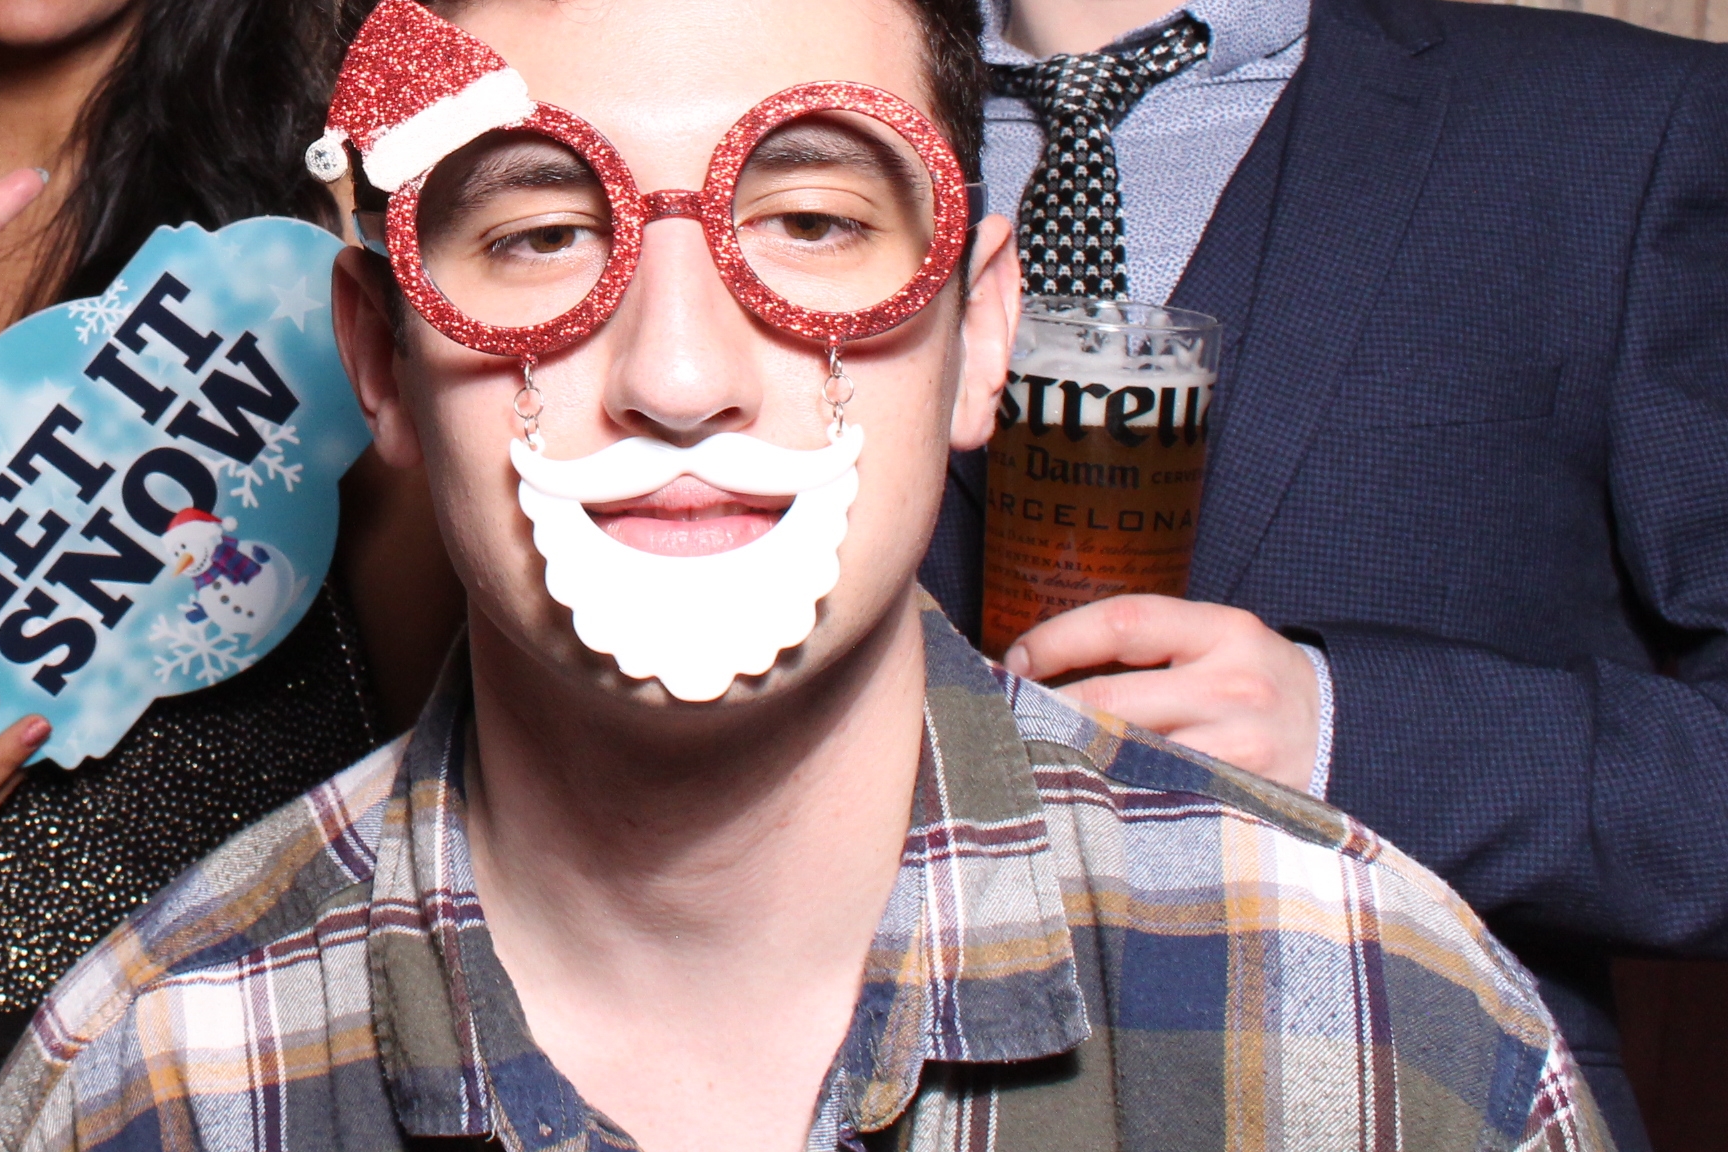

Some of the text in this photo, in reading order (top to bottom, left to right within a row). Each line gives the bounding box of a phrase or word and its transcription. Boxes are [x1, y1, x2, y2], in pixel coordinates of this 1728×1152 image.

[83, 270, 224, 426] IT
[995, 369, 1215, 448] strell
[1024, 444, 1140, 490] Damm
[986, 487, 1193, 532] ARCELONA
